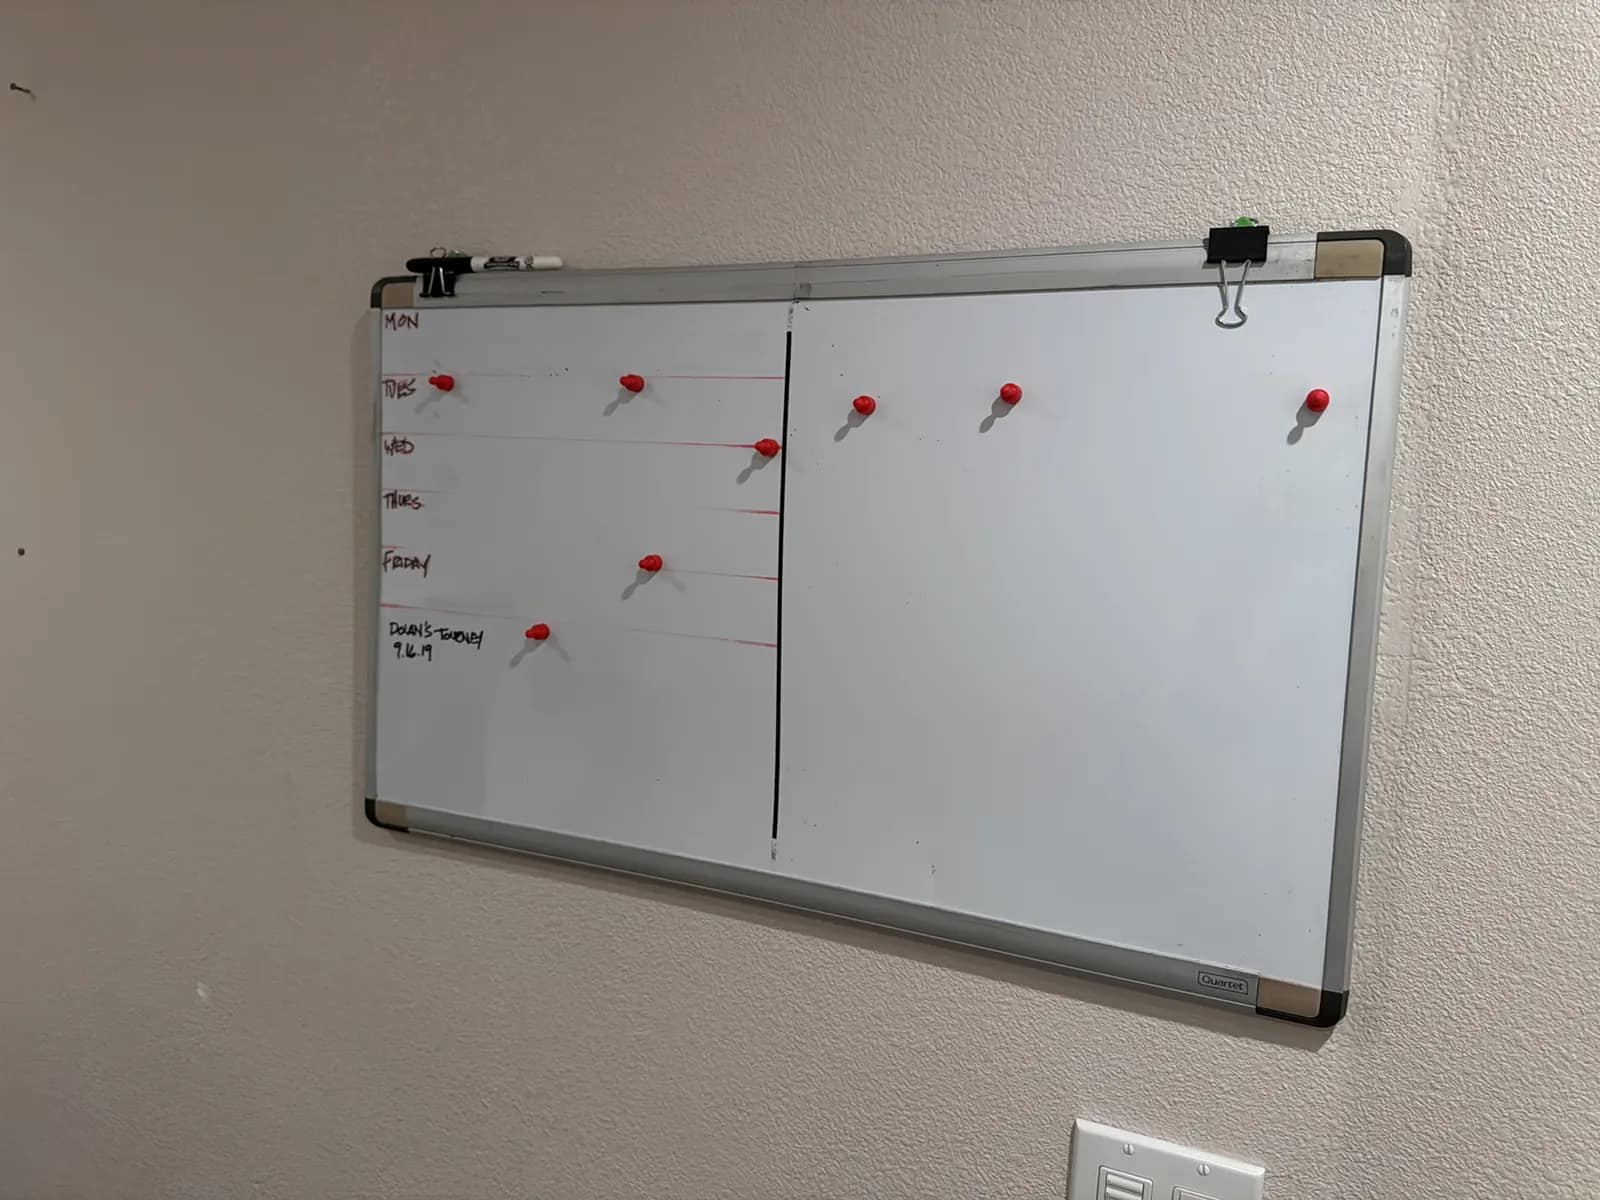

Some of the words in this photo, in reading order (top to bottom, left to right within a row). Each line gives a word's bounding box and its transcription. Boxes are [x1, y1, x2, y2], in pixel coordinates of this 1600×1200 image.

[384, 312, 419, 331] MON
[382, 378, 416, 399] TUES
[384, 437, 415, 456] WED
[383, 550, 431, 578] FRIDAY
[389, 621, 433, 638] DOLAN'S
[1201, 975, 1245, 990] Quartet
